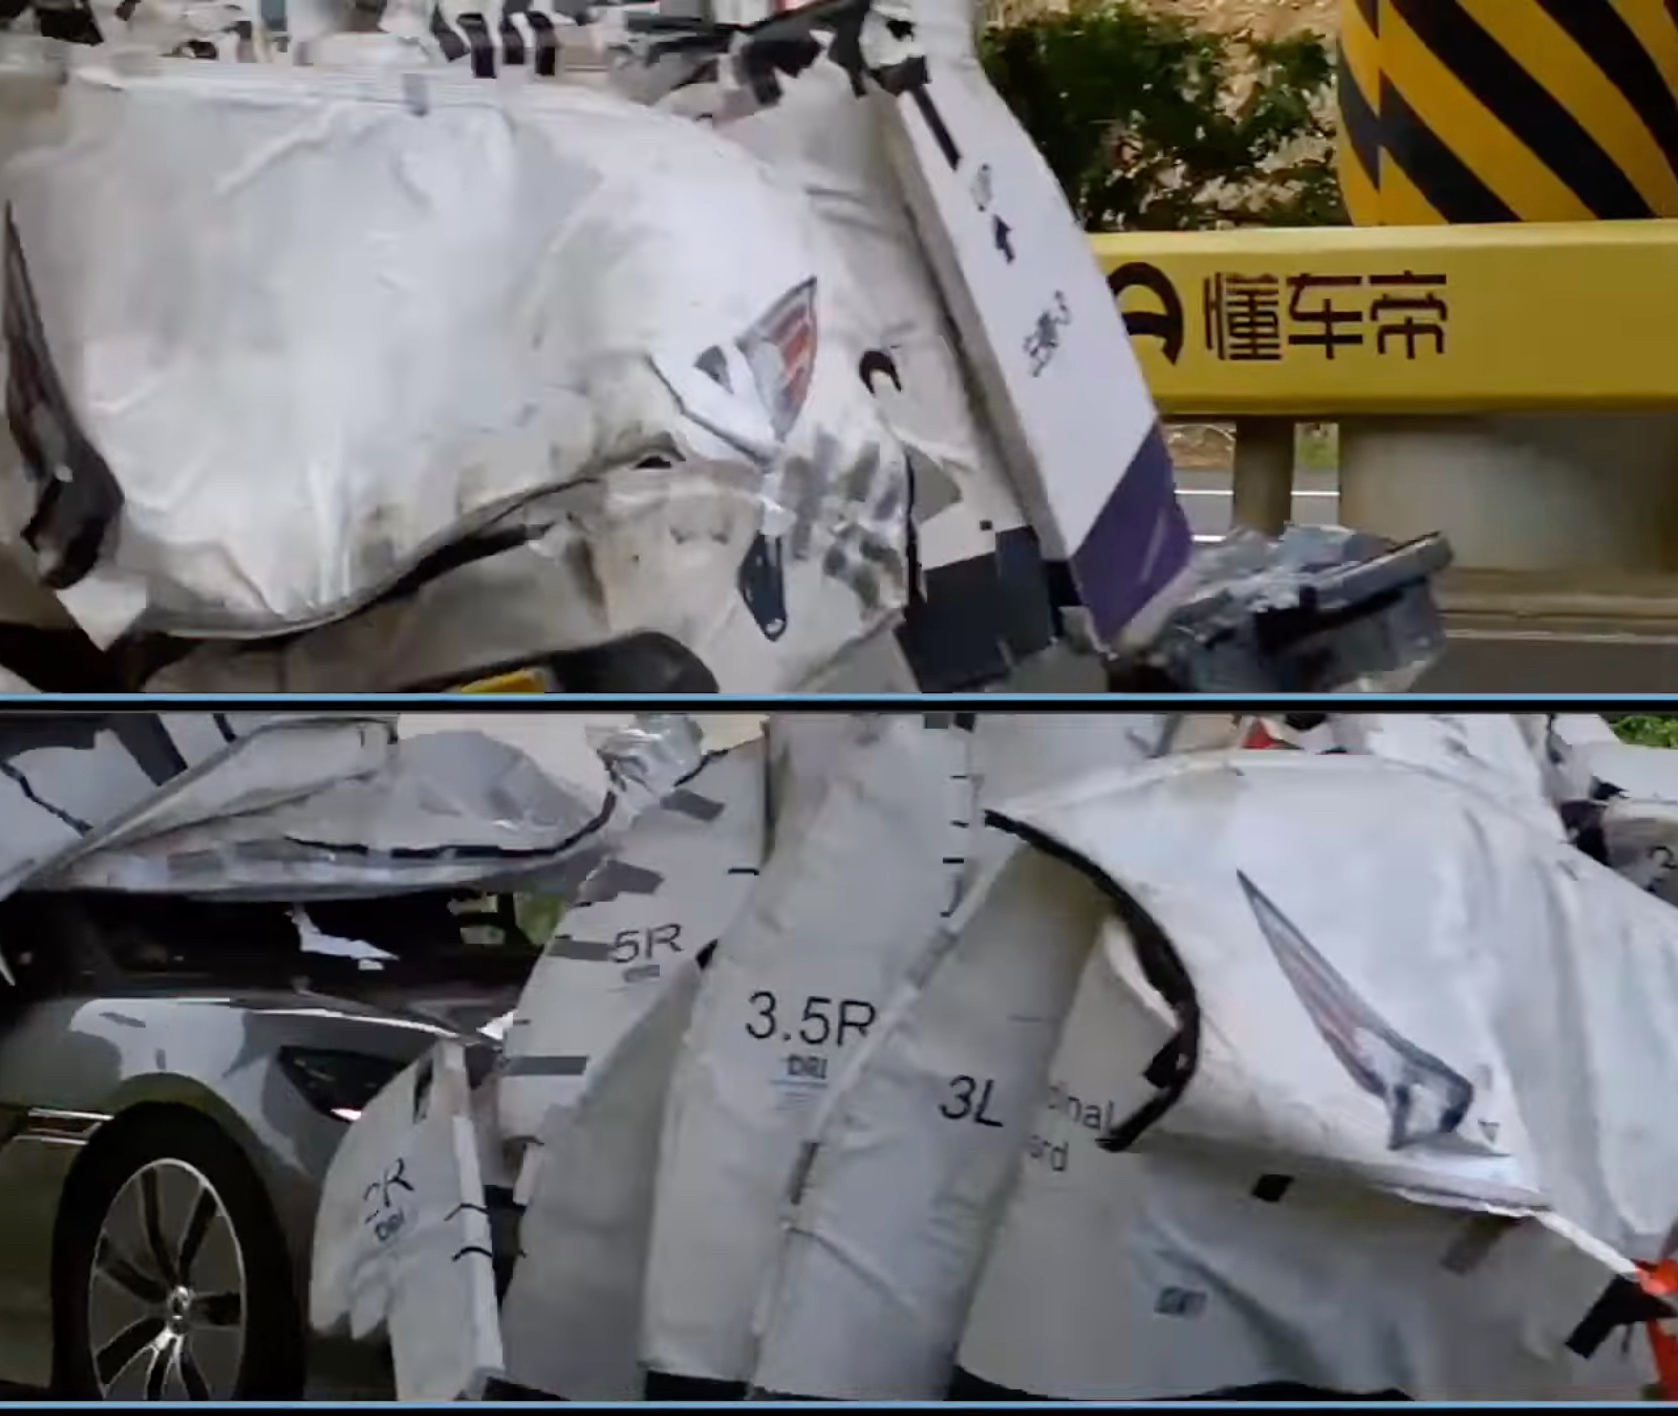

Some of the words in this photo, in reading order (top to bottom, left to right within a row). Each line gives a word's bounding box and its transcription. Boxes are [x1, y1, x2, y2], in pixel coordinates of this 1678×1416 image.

[1202, 270, 1449, 362] 懂车帝
[746, 991, 878, 1047] 3.5R
[938, 1074, 1004, 1128] 3L
